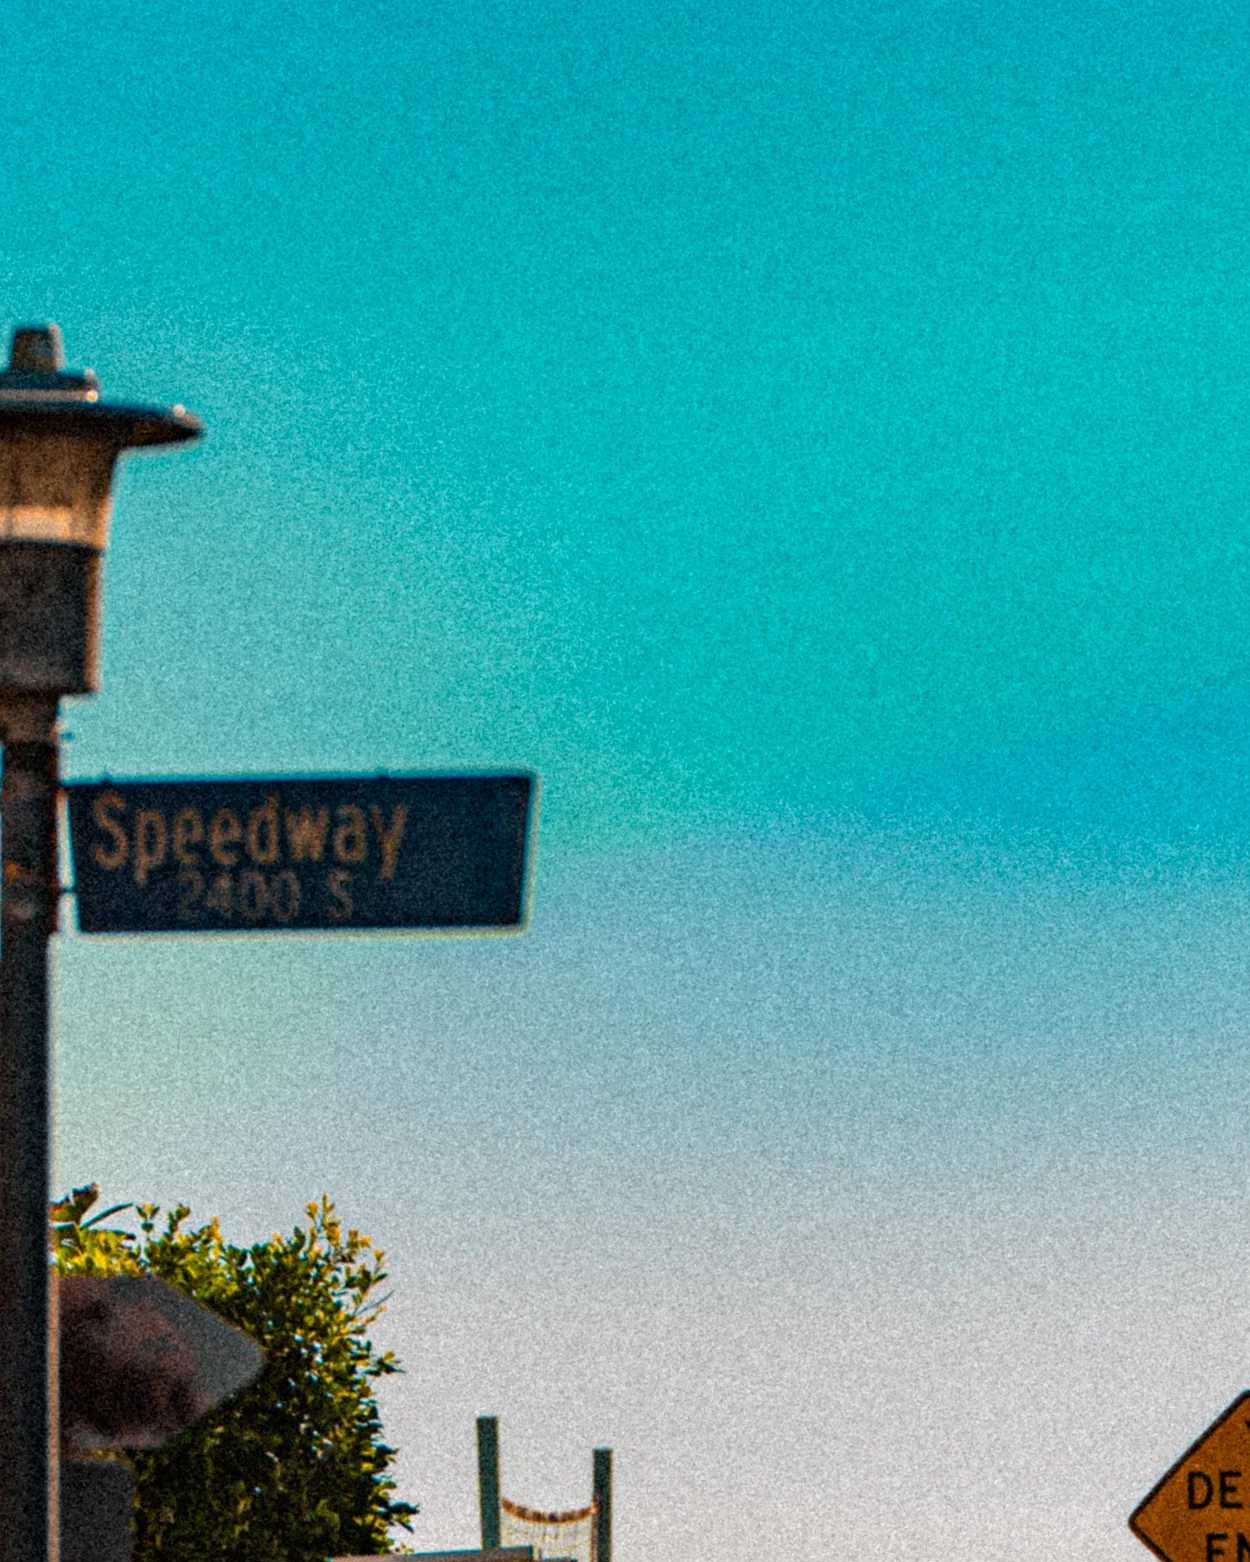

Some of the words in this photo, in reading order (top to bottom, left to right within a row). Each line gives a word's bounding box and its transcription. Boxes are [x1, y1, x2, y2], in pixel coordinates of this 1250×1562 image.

[92, 794, 408, 885] Speedway
[179, 869, 300, 920] 2400
[326, 869, 355, 920] S
